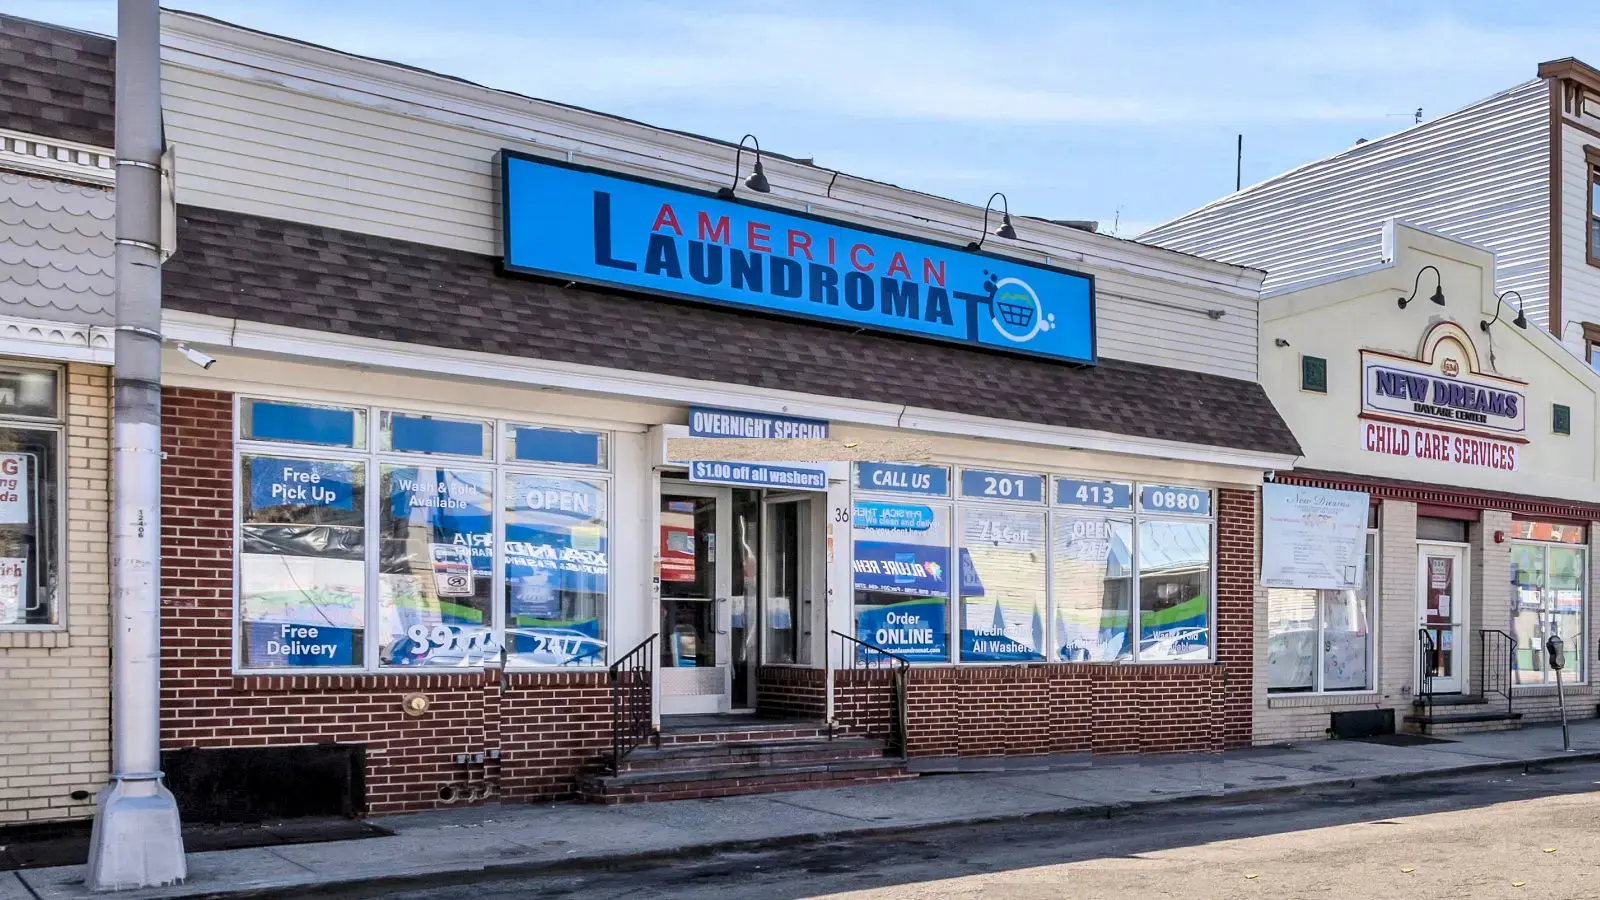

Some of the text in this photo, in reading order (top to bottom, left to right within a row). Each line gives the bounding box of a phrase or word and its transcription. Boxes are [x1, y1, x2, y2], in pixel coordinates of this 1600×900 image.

[652, 203, 947, 287] AMERICAN
[593, 190, 992, 343] LAUNDROMAT
[1376, 370, 1518, 419] NEW DREAMS
[1414, 403, 1487, 424] DAYCARE CENTER
[693, 411, 771, 438] OVERNIGHT
[1366, 423, 1515, 472] CHILD CARE SERVICES
[283, 467, 321, 483] Free
[696, 462, 824, 486] $1.00 off all washers!
[871, 470, 931, 490] CALL US
[271, 484, 336, 504] Pick Up
[399, 479, 477, 496] Wash & Fold
[983, 477, 1025, 498] 201
[1075, 484, 1114, 505] 413
[408, 495, 467, 509] Available
[525, 490, 589, 513] OPEN
[1152, 491, 1200, 511] 0880
[834, 507, 849, 523] 36
[1073, 520, 1114, 538] OPEN
[886, 611, 920, 625] Order
[281, 625, 318, 639] Free
[875, 628, 934, 645] ONLINE
[1182, 631, 1199, 641] Fold
[267, 640, 338, 658] Delivery
[972, 640, 1034, 654] All Washers
